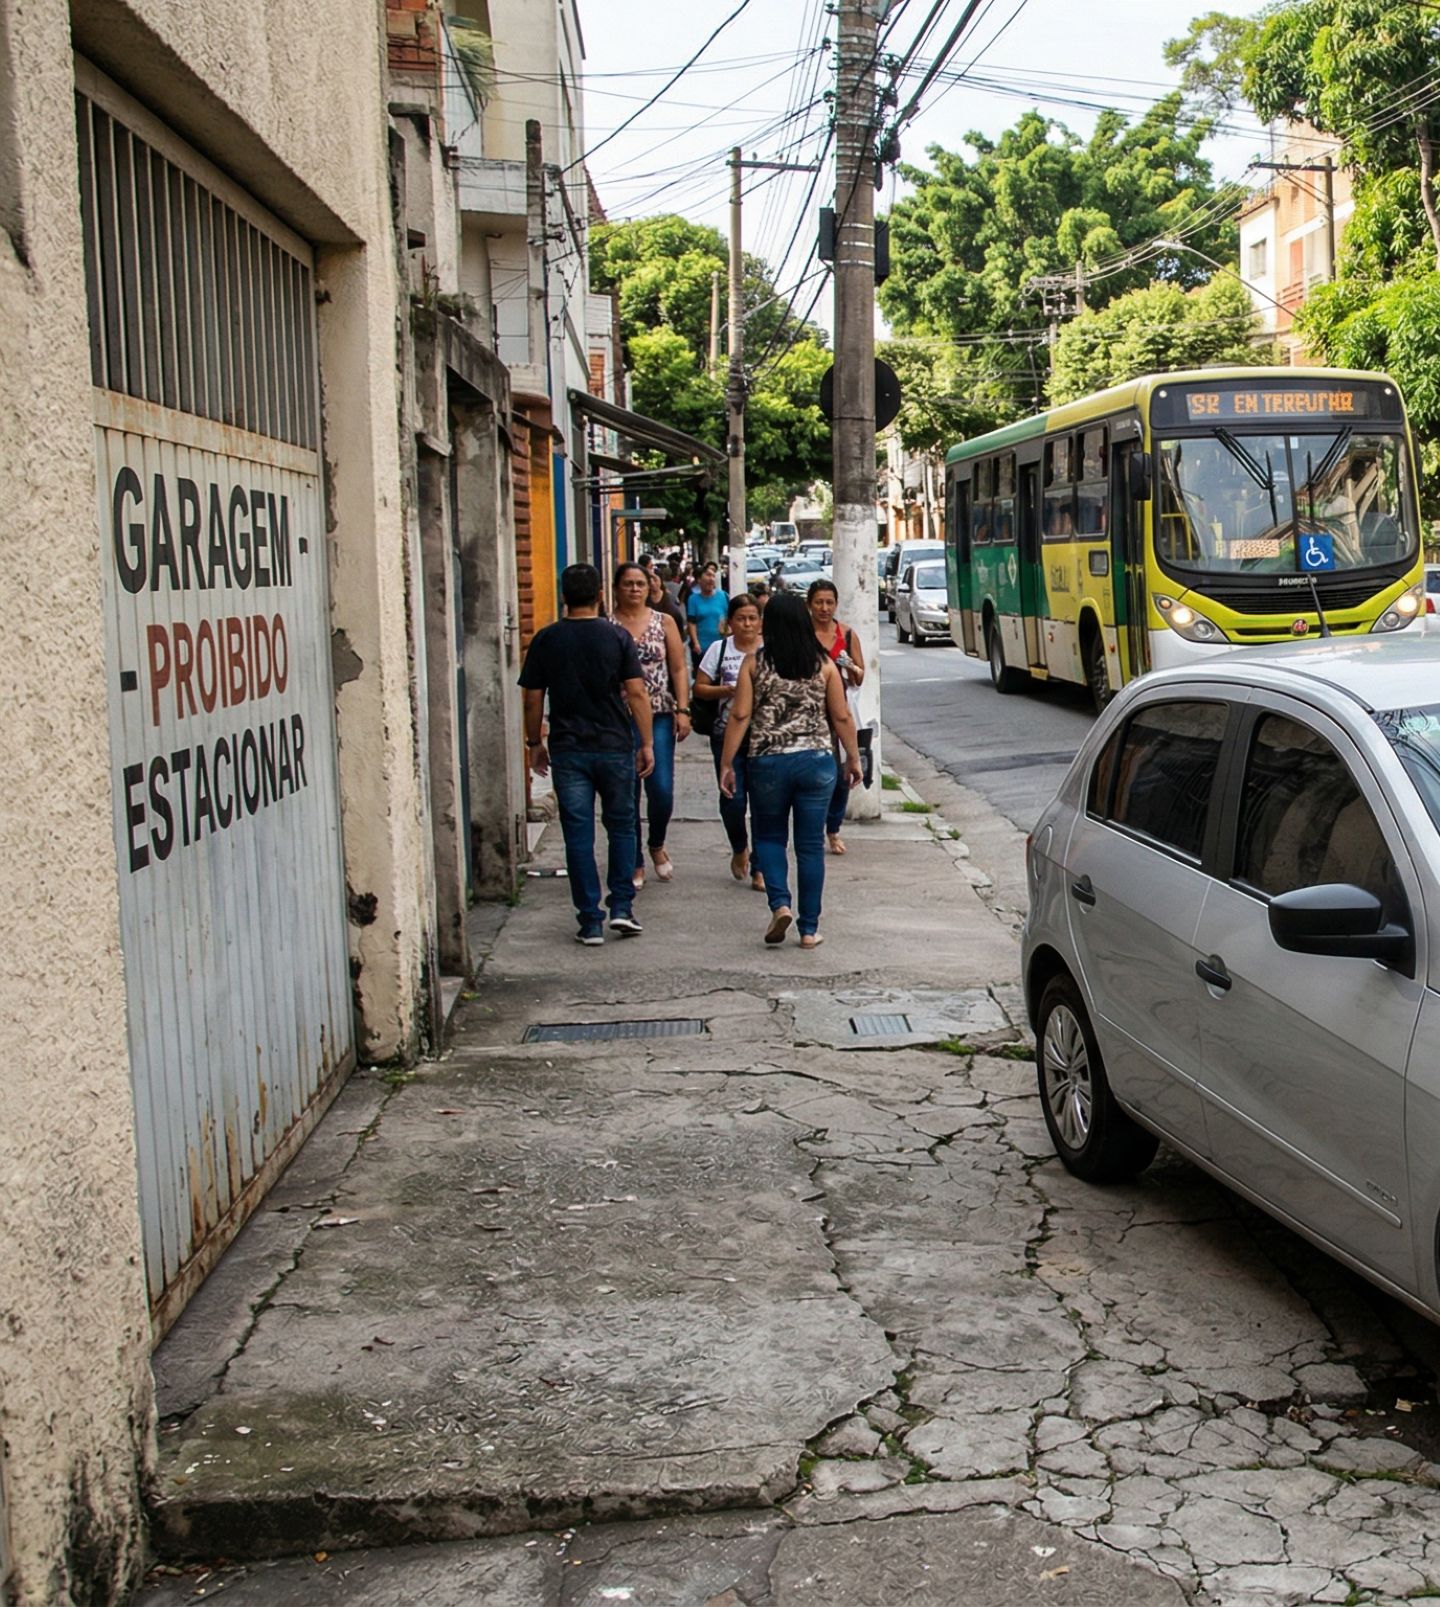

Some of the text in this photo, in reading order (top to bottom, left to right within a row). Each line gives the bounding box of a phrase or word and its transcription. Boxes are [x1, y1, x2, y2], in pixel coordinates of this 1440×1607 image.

[113, 466, 292, 594] GARAGEM
[146, 613, 288, 726] PROIBIDO
[123, 713, 308, 874] ESTACIONAR
